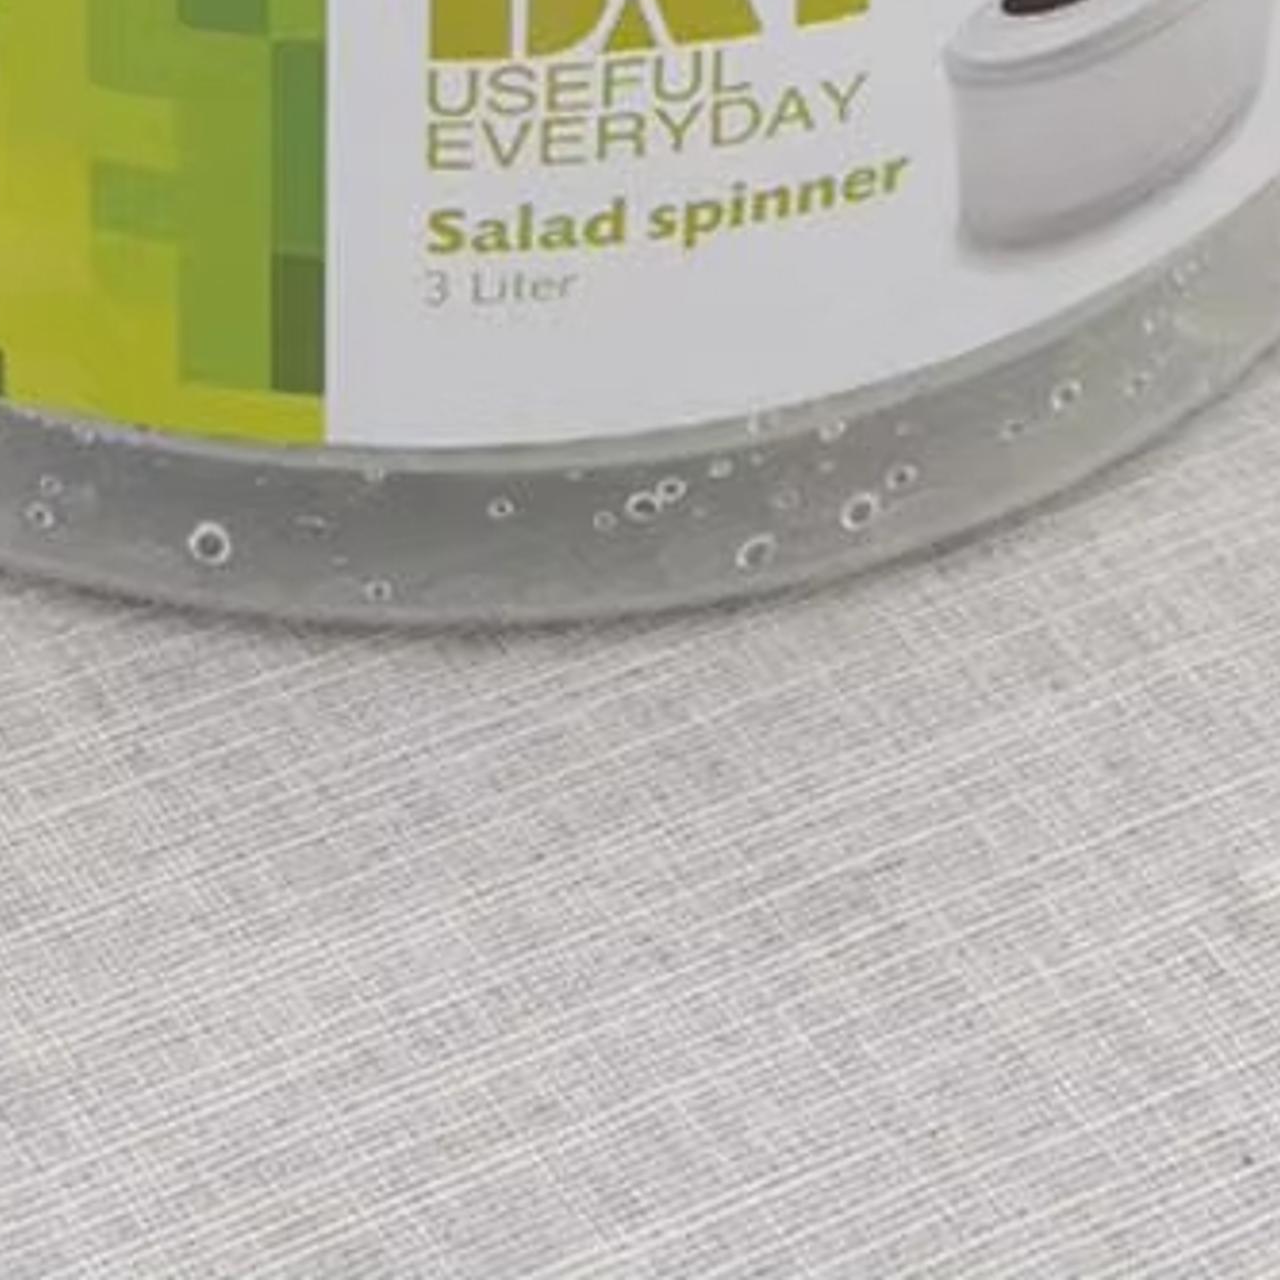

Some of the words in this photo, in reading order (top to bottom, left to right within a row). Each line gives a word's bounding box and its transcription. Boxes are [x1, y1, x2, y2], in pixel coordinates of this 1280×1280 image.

[426, 72, 869, 171] EVERYDAY
[427, 49, 753, 118] USEFUL
[426, 198, 627, 256] Salad
[647, 156, 910, 248] spinner
[423, 270, 450, 308] 3
[471, 269, 578, 306] Liter
